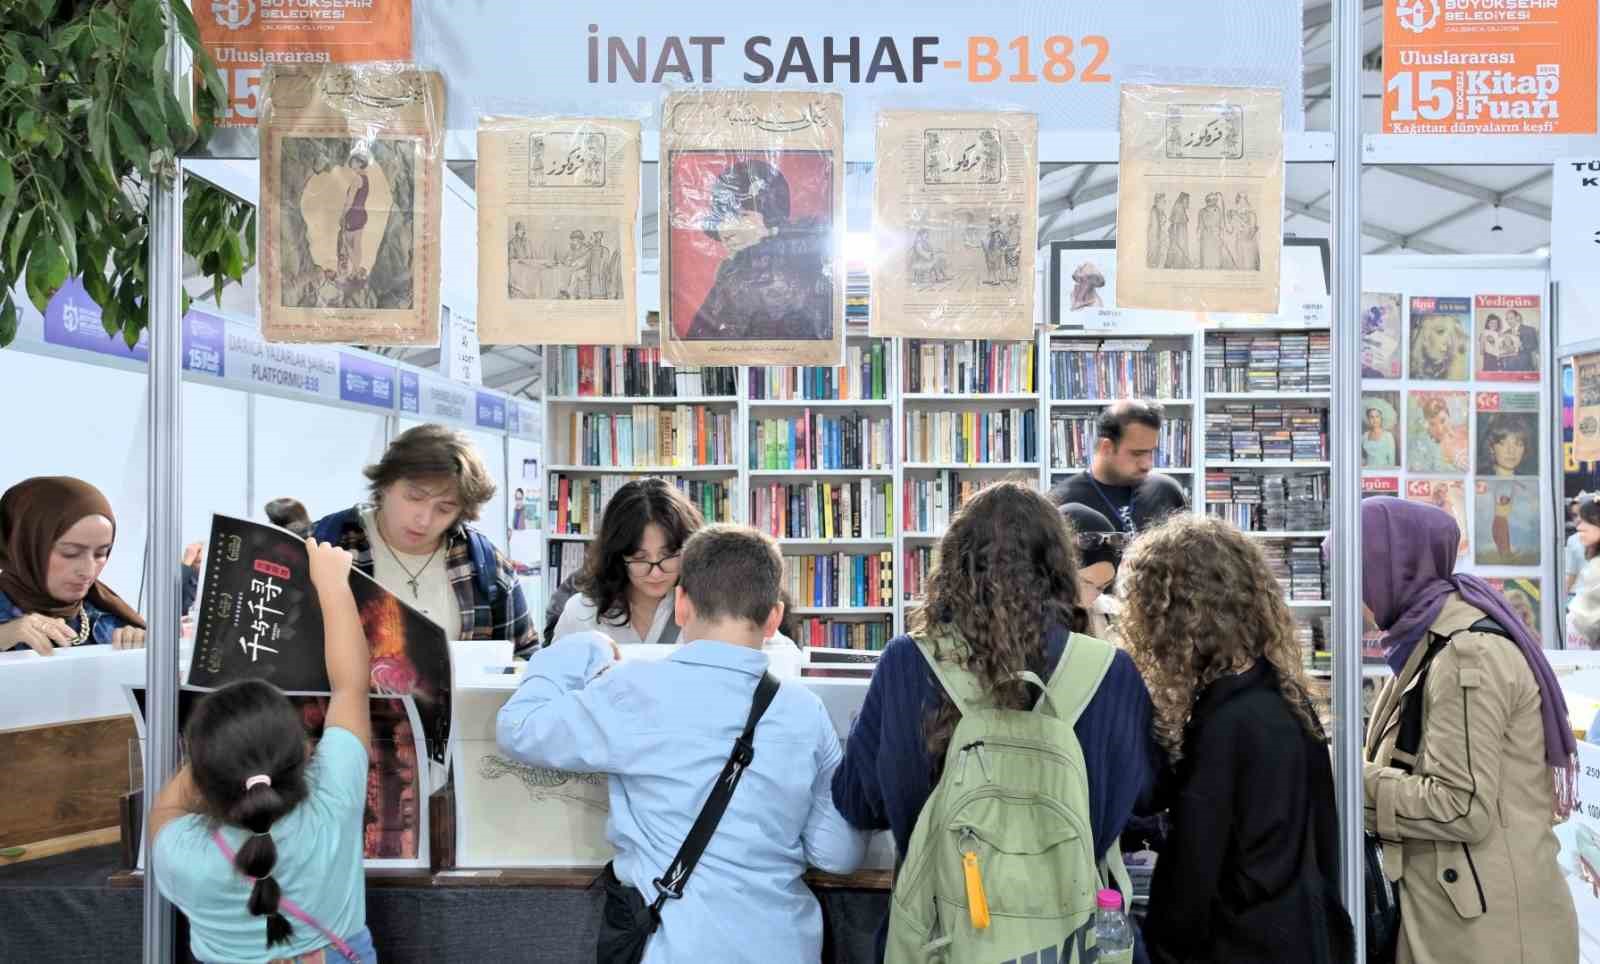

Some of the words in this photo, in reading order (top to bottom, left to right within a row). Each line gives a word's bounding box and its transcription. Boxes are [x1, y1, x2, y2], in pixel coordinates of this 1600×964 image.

[261, 9, 345, 19] BELEDİYESİ
[1444, 11, 1531, 21] BELEDİYESİ
[215, 48, 331, 63] Uluslararası
[587, 23, 725, 84] İNAT
[743, 35, 1112, 84] SAHAF-B182
[1400, 51, 1516, 65] Uluslararası
[1467, 70, 1560, 99] Kitap
[1388, 71, 1454, 120] 15
[1467, 95, 1559, 120] Fuarı
[1477, 295, 1532, 308] Yedigün
[239, 576, 284, 662] 千与千寻
